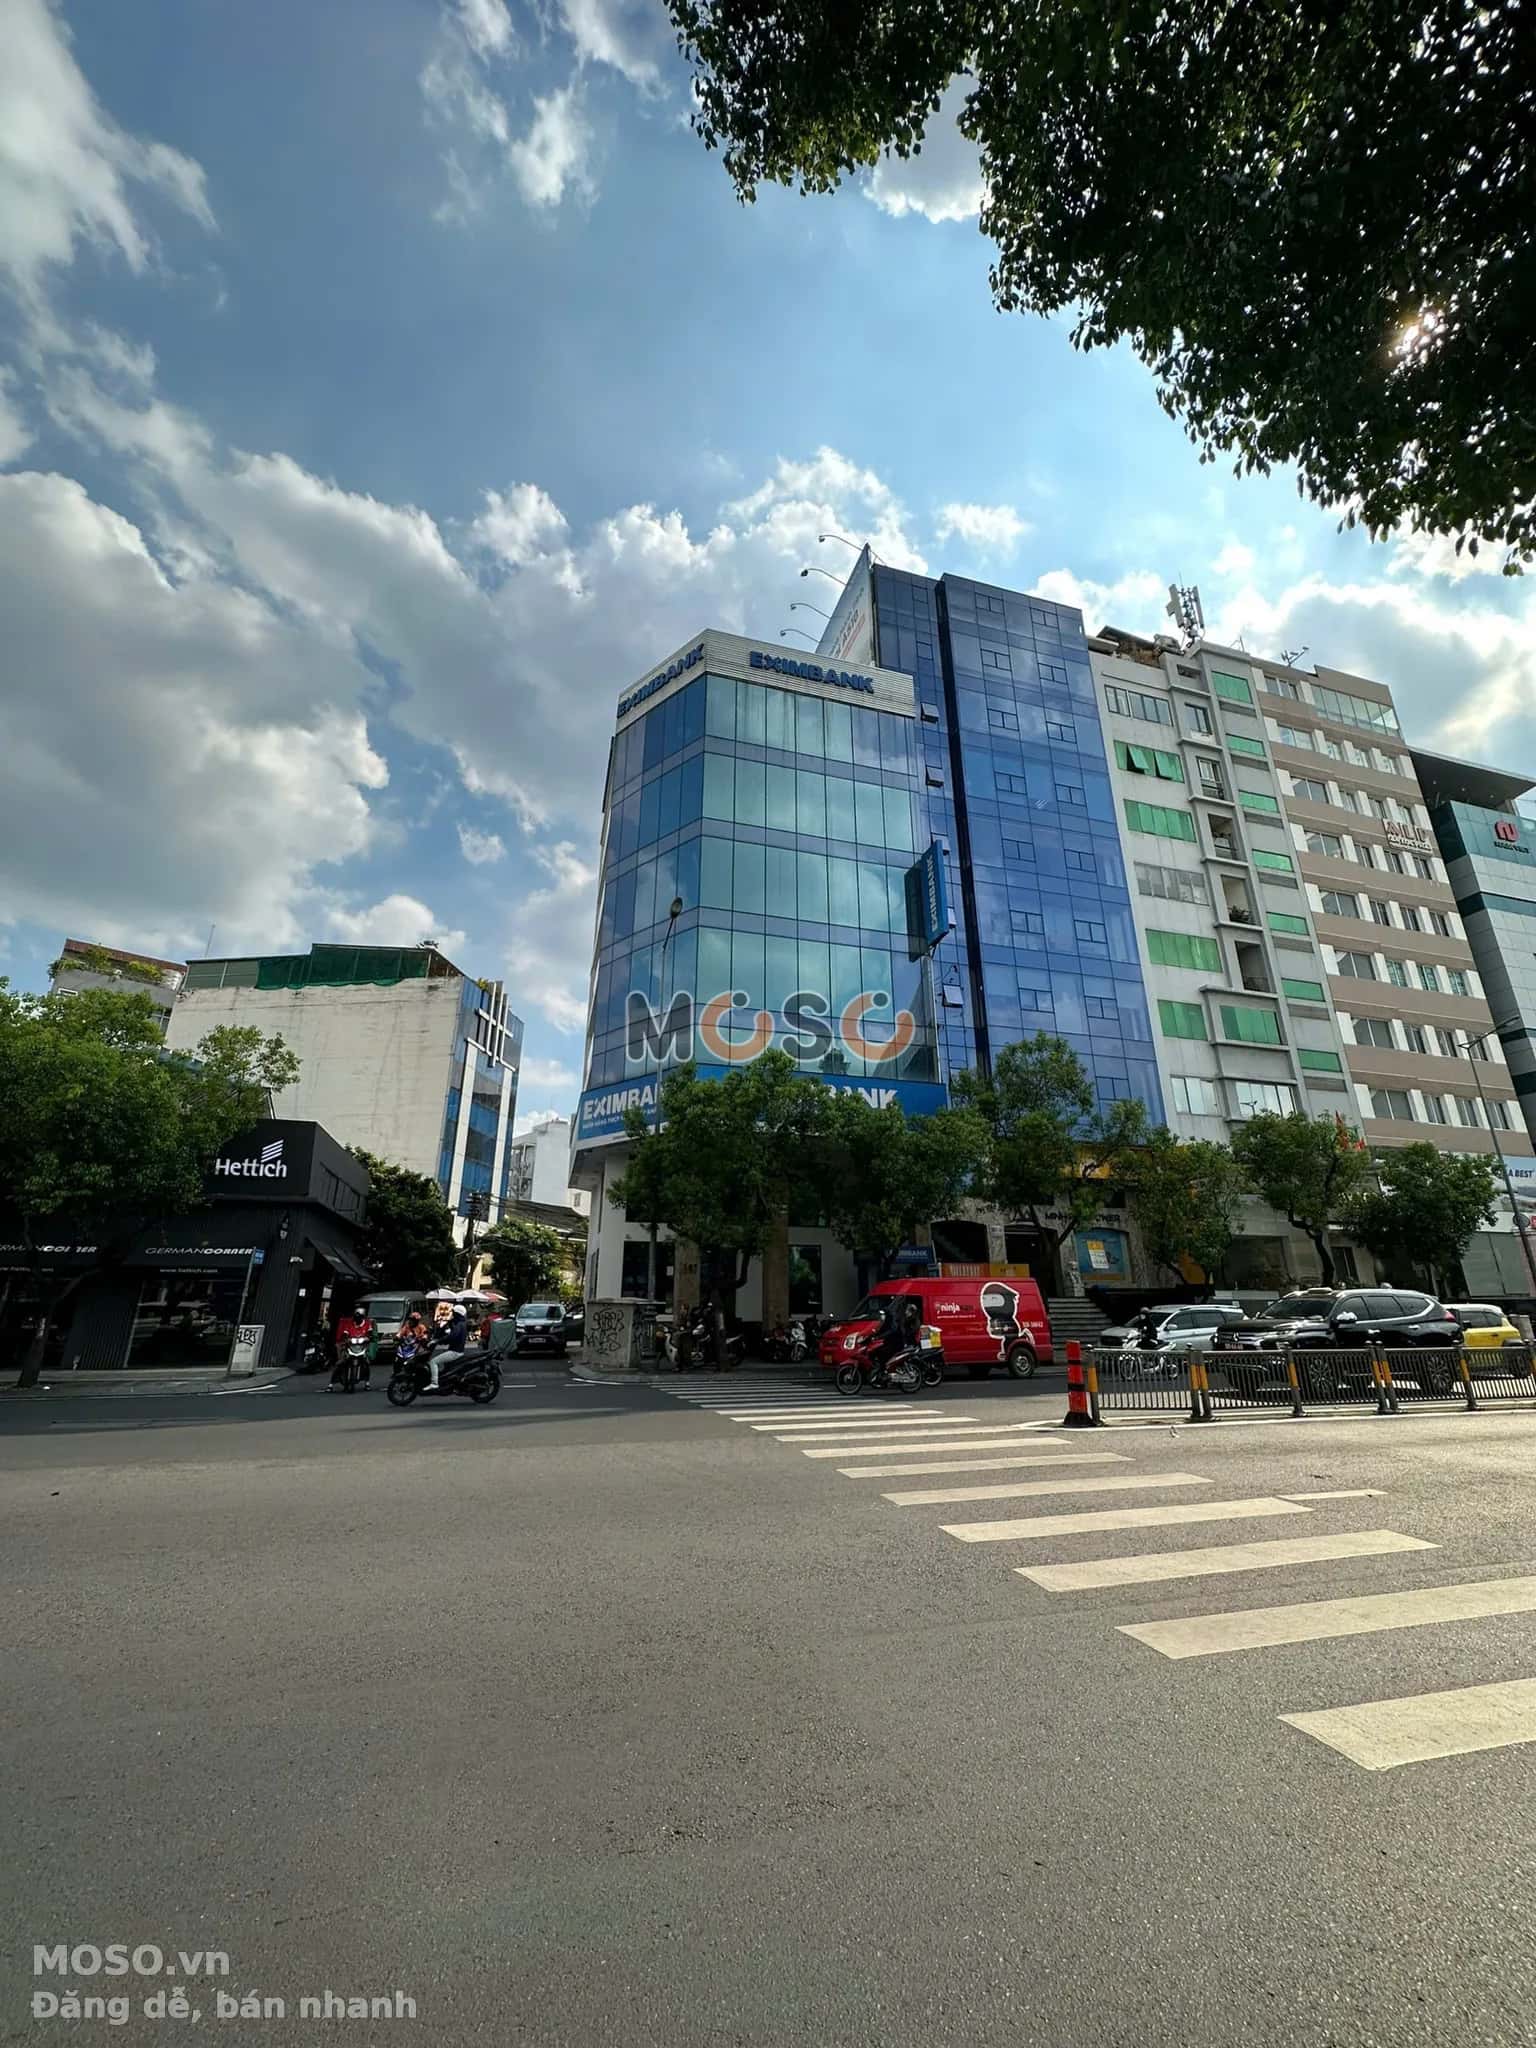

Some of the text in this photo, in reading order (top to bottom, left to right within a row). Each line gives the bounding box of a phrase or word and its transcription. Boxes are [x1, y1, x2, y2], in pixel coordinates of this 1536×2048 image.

[617, 643, 704, 719] EXIMBANK
[749, 650, 875, 693] EXIMBANK
[583, 1083, 658, 1120] EXIMBA
[214, 1158, 287, 1178] Hettich
